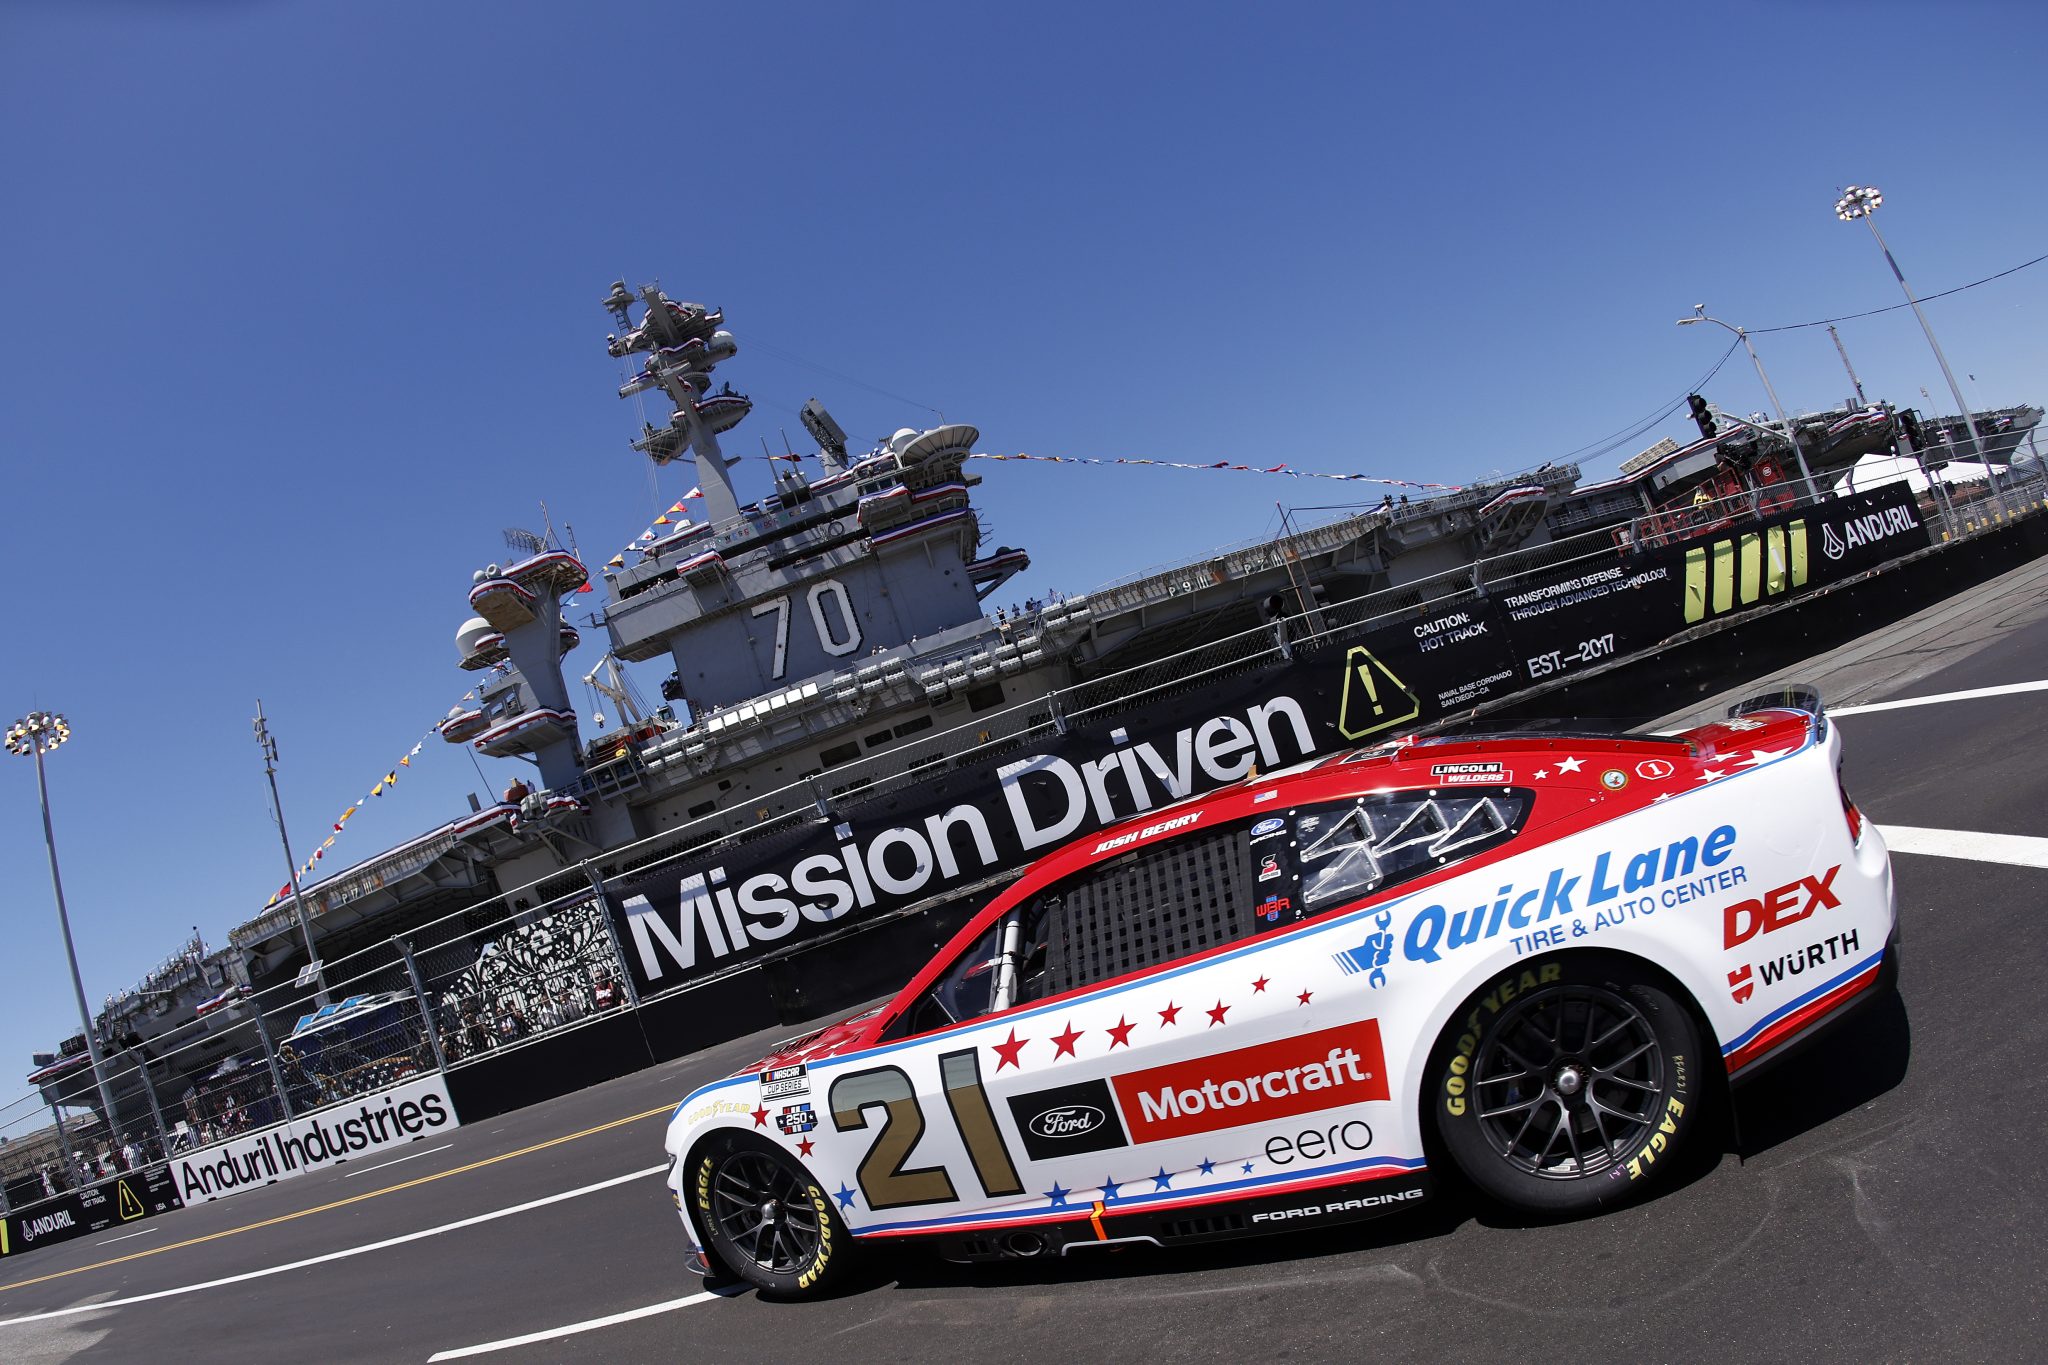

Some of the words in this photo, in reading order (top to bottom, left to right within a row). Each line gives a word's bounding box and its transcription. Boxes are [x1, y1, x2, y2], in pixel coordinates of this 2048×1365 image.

[1844, 504, 1919, 549] ANDURIL
[1503, 579, 1582, 609] TRANSFORMING
[1582, 567, 1623, 587] DEFENSE
[1509, 601, 1560, 622] THROUGH
[1560, 585, 1610, 608] ADVANCED
[1611, 567, 1668, 593] TECHNOLOGY
[751, 577, 865, 680] 70
[1413, 612, 1471, 638] CAUTION:
[1419, 634, 1445, 653] HOT
[1447, 622, 1488, 644] TRACK
[1438, 687, 1459, 700] NAVAL
[1459, 681, 1476, 693] BASE
[1476, 670, 1512, 688] CORONADO
[1441, 697, 1454, 708] SAN
[1434, 764, 1498, 774] LINCOLN
[1447, 773, 1504, 783] WELDERS
[1647, 763, 1663, 776] 1
[622, 804, 1000, 981] Mission
[997, 695, 1317, 852] Driven
[1091, 831, 1138, 856] JOSH
[1140, 811, 1204, 839] BERRY
[1256, 897, 1291, 917] WBR
[1402, 867, 1593, 965] Quick
[1586, 824, 1737, 905] Lane
[1510, 925, 1566, 956] TIRE
[1572, 918, 1590, 938] &
[1594, 895, 1655, 933] AUTO
[1659, 866, 1748, 909] CENTER
[1723, 864, 1843, 951] DEX
[1447, 962, 1562, 1116] GOODYEAR
[767, 1084, 780, 1094] CUP
[780, 1079, 802, 1091] SERIES
[773, 1067, 800, 1080] NASCAR
[786, 1112, 807, 1126] 250
[828, 1046, 1026, 1212] 21
[1043, 1110, 1092, 1135] Ford
[1625, 1096, 1685, 1181] EAGLE
[182, 1136, 280, 1200] Anduril
[274, 1093, 448, 1172] Industries
[1265, 1120, 1373, 1165] eero
[698, 1156, 715, 1211] EAGLE
[32, 1209, 76, 1237] ANDURIL
[1252, 1205, 1323, 1224] FORD
[1325, 1188, 1424, 1213] RACING
[798, 1185, 833, 1290] GOODYEAR
